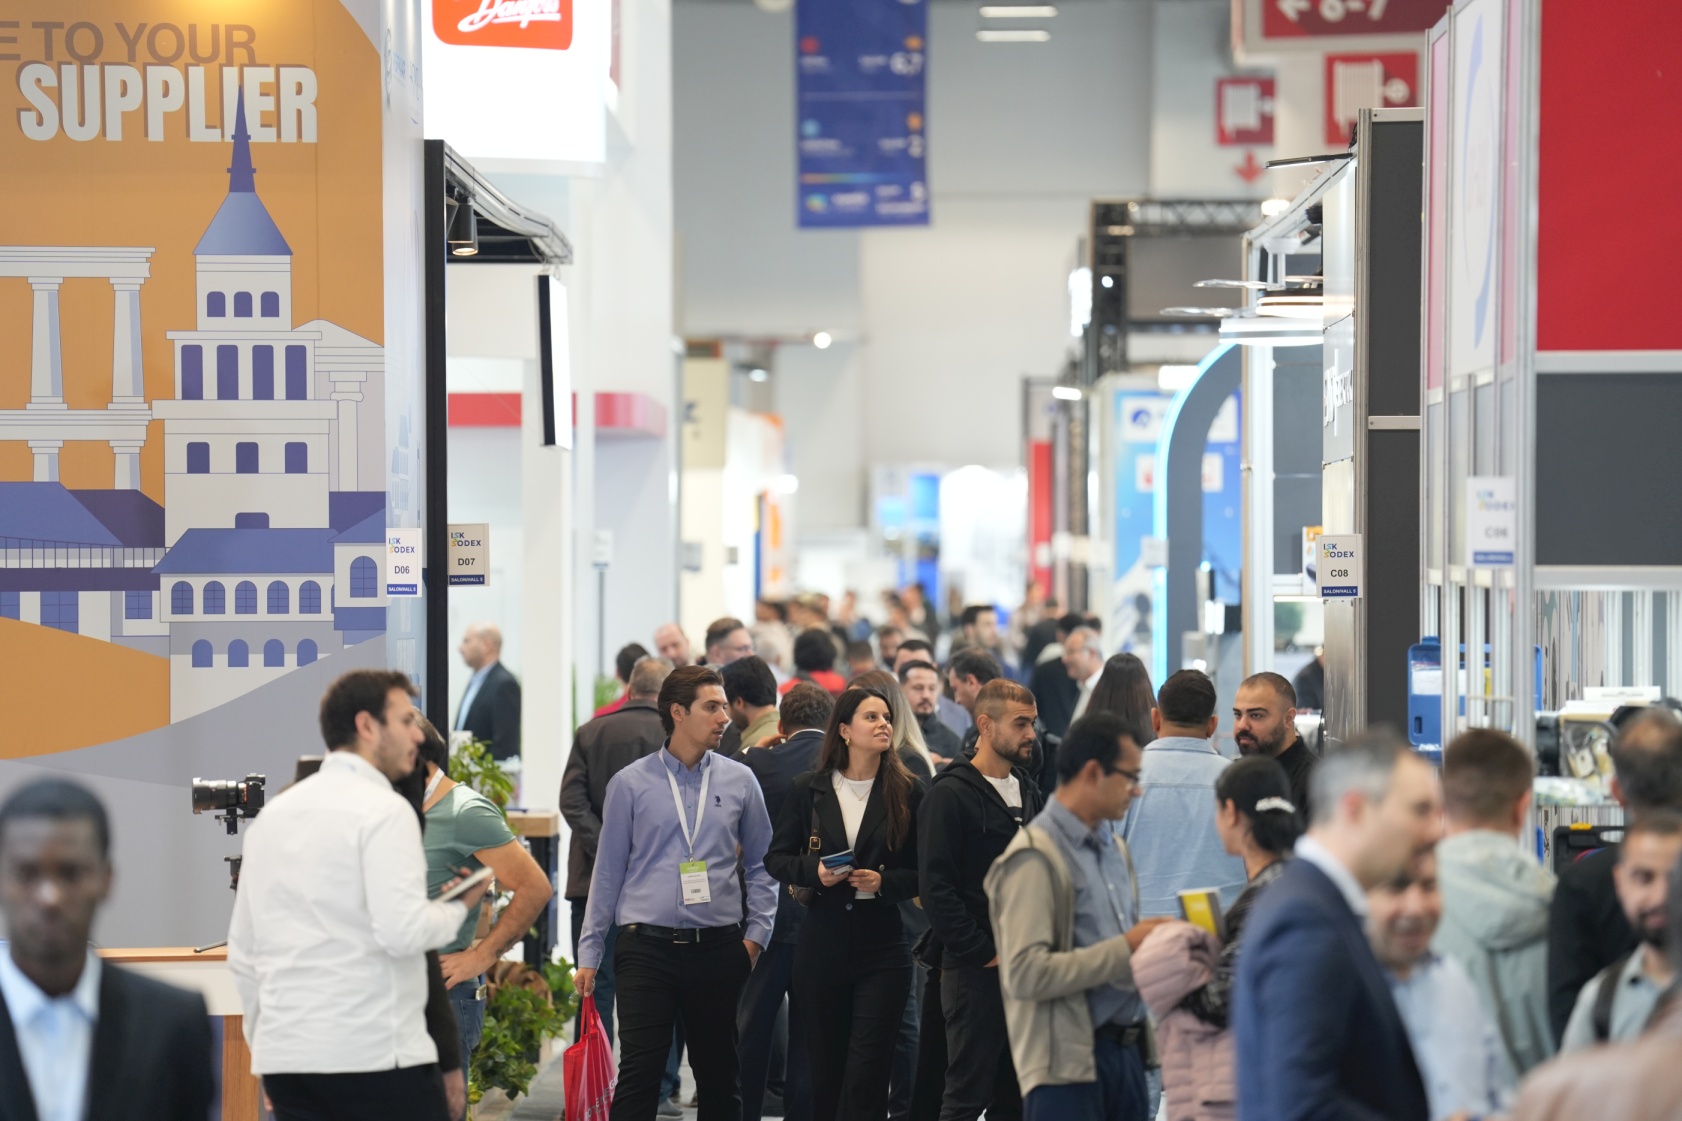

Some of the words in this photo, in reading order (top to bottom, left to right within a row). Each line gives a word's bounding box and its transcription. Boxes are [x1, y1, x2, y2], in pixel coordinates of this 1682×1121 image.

[32, 22, 104, 62] TO
[114, 22, 257, 64] YOUR
[18, 63, 318, 143] SUPPLIER
[388, 537, 401, 545] ISK
[451, 539, 482, 547] SODEX
[389, 546, 416, 554] SODEX
[1324, 550, 1355, 558] SODEX
[457, 558, 476, 566] D07
[394, 565, 410, 575] D06
[1330, 569, 1349, 578] C08
